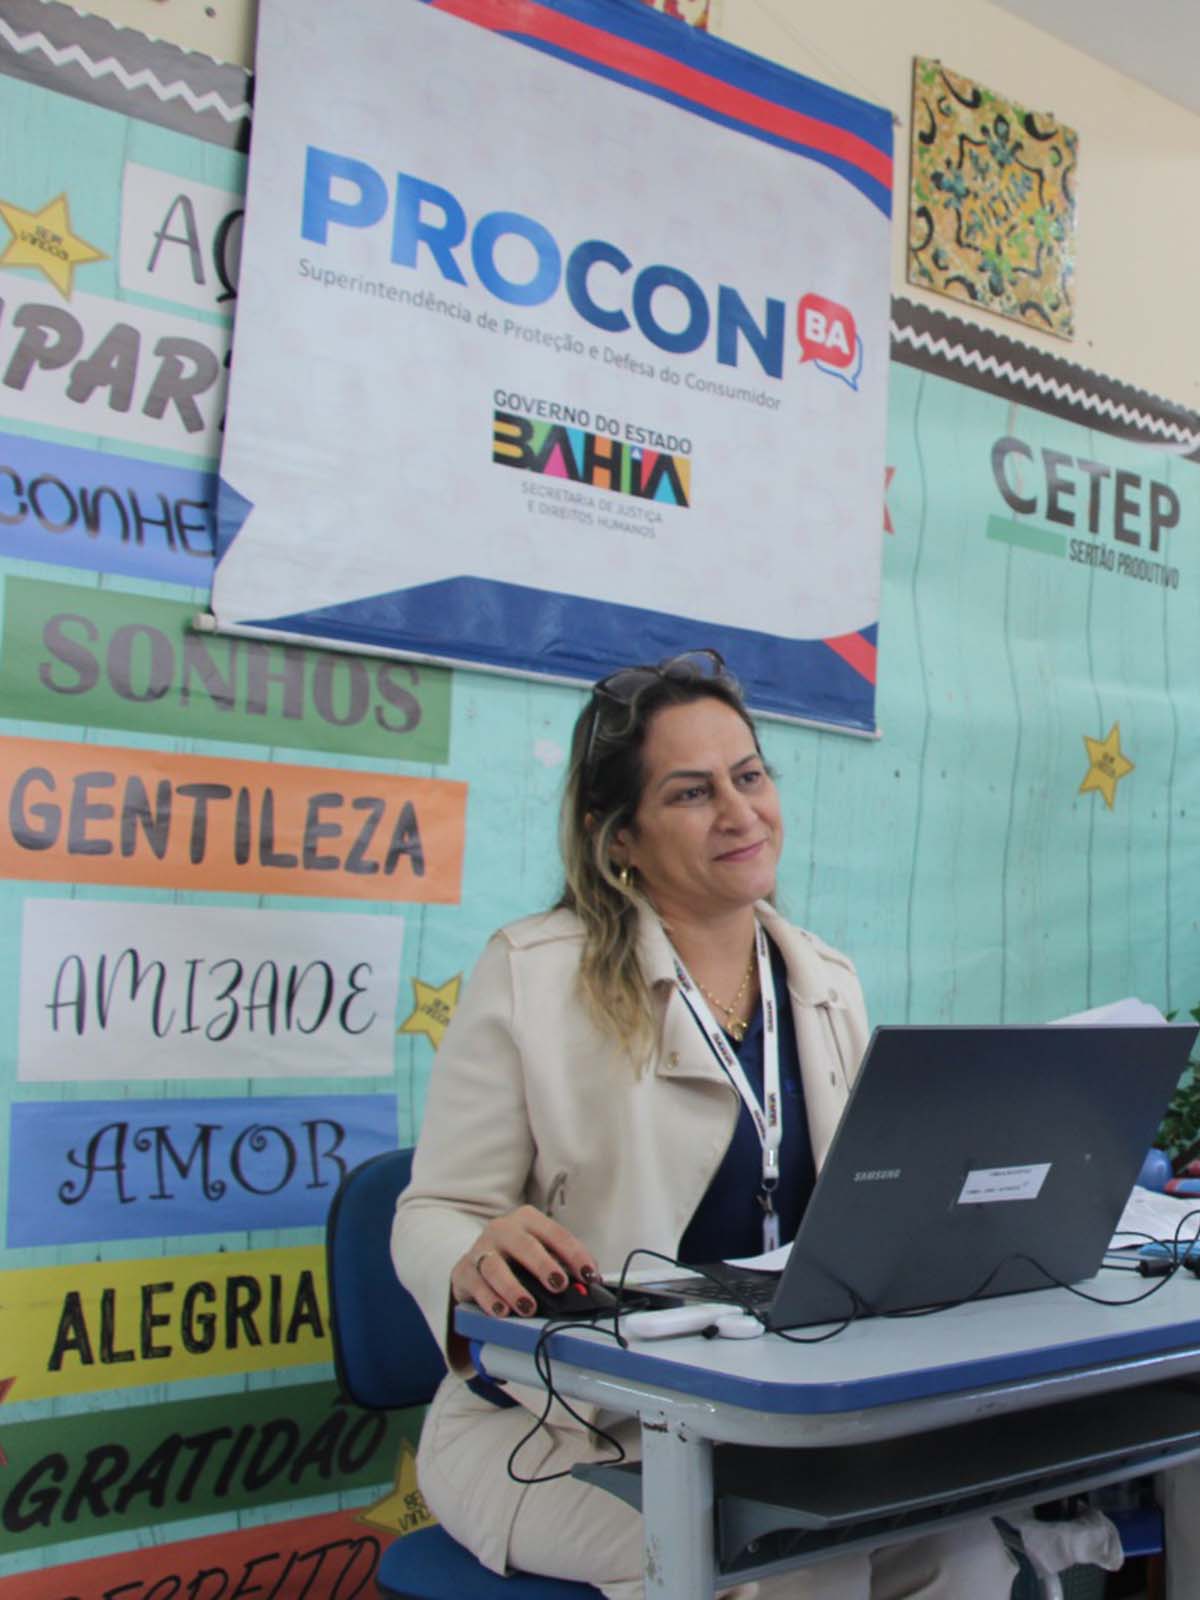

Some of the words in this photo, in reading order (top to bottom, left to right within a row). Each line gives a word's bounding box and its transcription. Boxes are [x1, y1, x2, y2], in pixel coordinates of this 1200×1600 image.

[301, 145, 786, 380] PROCON
[804, 308, 850, 356] BA
[0, 295, 232, 434] PAR
[298, 257, 473, 324] Superintendência
[476, 311, 499, 333] de
[502, 318, 585, 357] Proteção
[588, 342, 600, 359] e
[603, 346, 656, 380] Defesa
[660, 366, 682, 387] do
[684, 372, 783, 411] Consumidor
[492, 409, 691, 509] BAHIA
[493, 389, 591, 428] GOVERNO
[595, 414, 621, 437] DO
[625, 423, 693, 455] ESTADO
[520, 480, 595, 509] SECRETARIA
[598, 497, 614, 514] DE
[991, 436, 1181, 553] CETEP
[1069, 537, 1116, 572] SERTÃO
[1117, 551, 1181, 591] PRODUTIVO
[38, 613, 424, 735] SONHOS
[8, 766, 426, 878] GENTILEZA
[45, 947, 378, 1042] AMIZADE
[58, 1119, 349, 1206] AMOR
[853, 1168, 902, 1183] SAMSUNG
[48, 1269, 325, 1373] ALEGRIA
